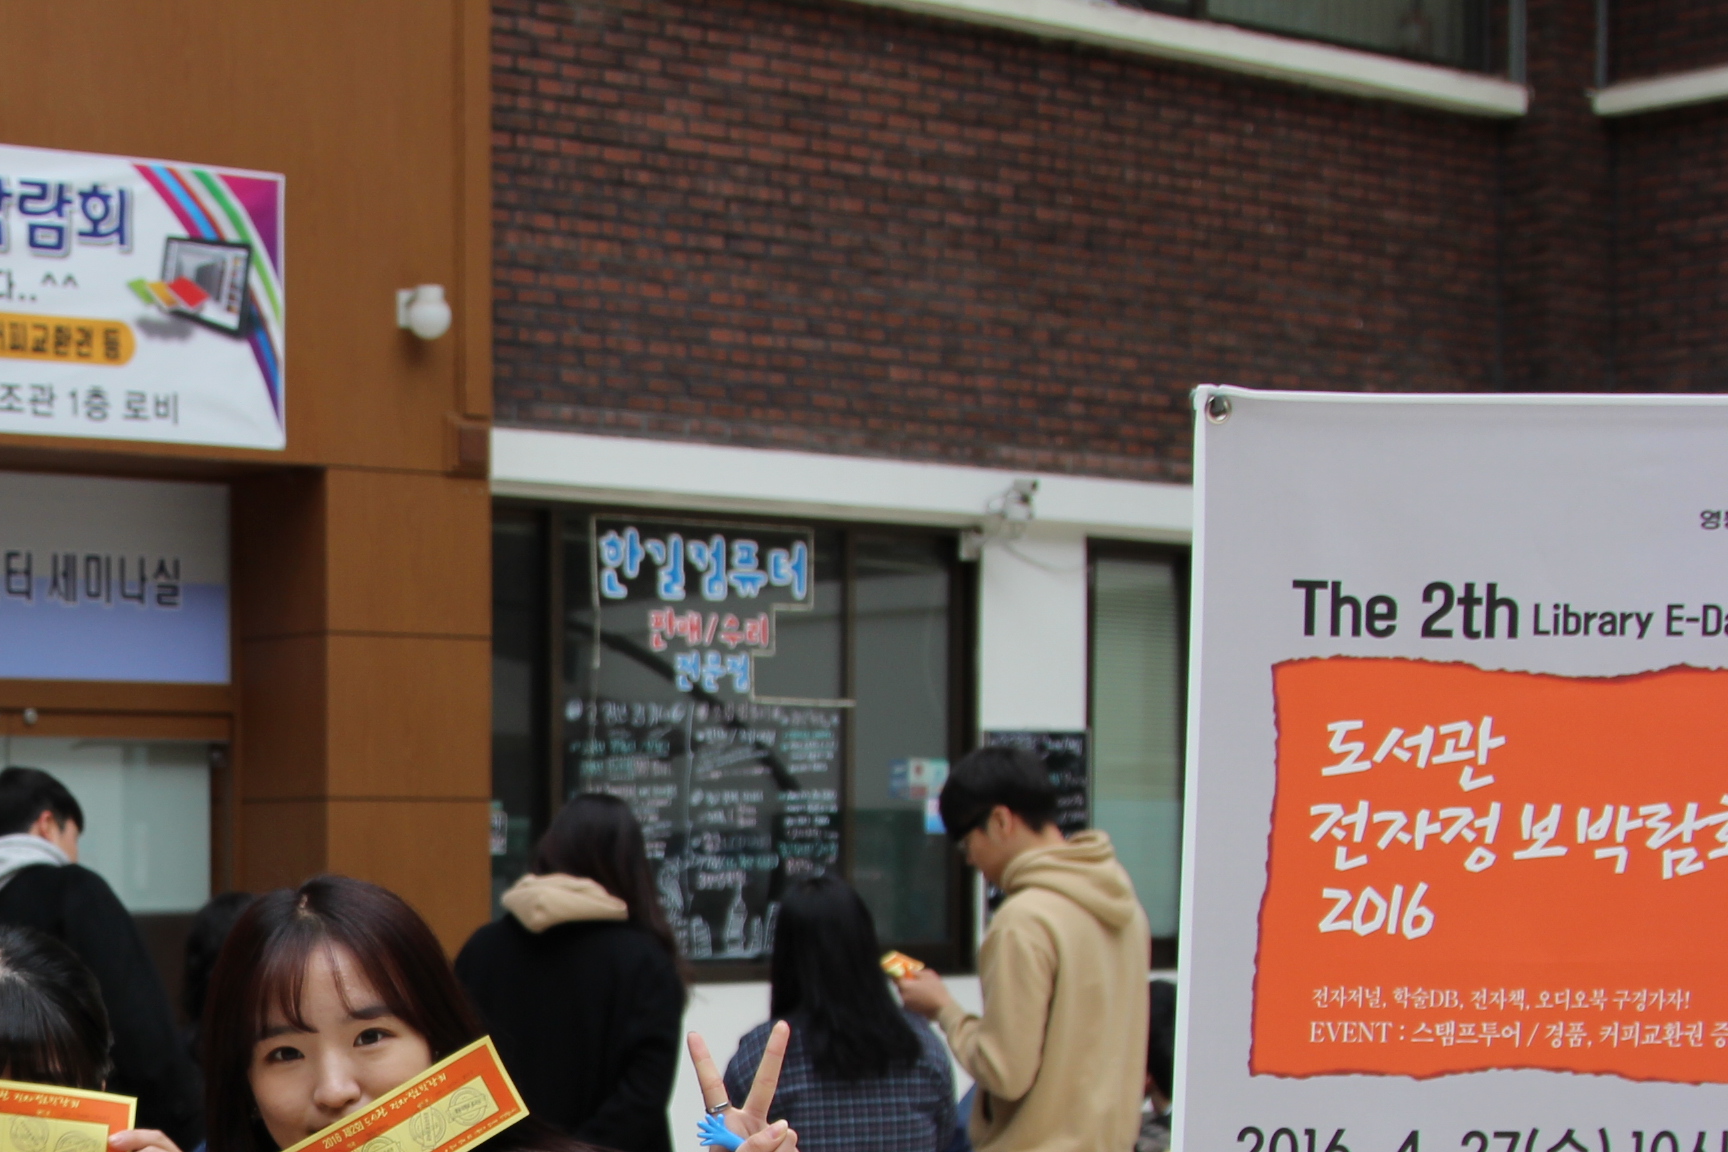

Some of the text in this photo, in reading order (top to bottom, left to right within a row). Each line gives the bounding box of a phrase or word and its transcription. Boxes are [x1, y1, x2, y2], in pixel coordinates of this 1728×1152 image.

[68, 387, 111, 422] 1층
[122, 389, 179, 425] 로비
[1699, 509, 1728, 531] 영
[49, 552, 181, 608] 세미나실
[1292, 579, 1399, 639] The
[1421, 581, 1519, 640] 2th
[1533, 603, 1654, 640] Library
[1321, 716, 1506, 793] 도서관
[1310, 800, 1568, 874] 전자정보
[1318, 882, 1436, 941] 2016
[1311, 986, 1692, 1013] 전자저널, 학술DB, 전자책, 오디오북 구경가자!
[1308, 1021, 1393, 1045] EVENT
[1411, 1020, 1522, 1049] 스탬프투어
[1545, 1020, 1594, 1050] 경품,
[1599, 1020, 1704, 1049] 커피교환권
